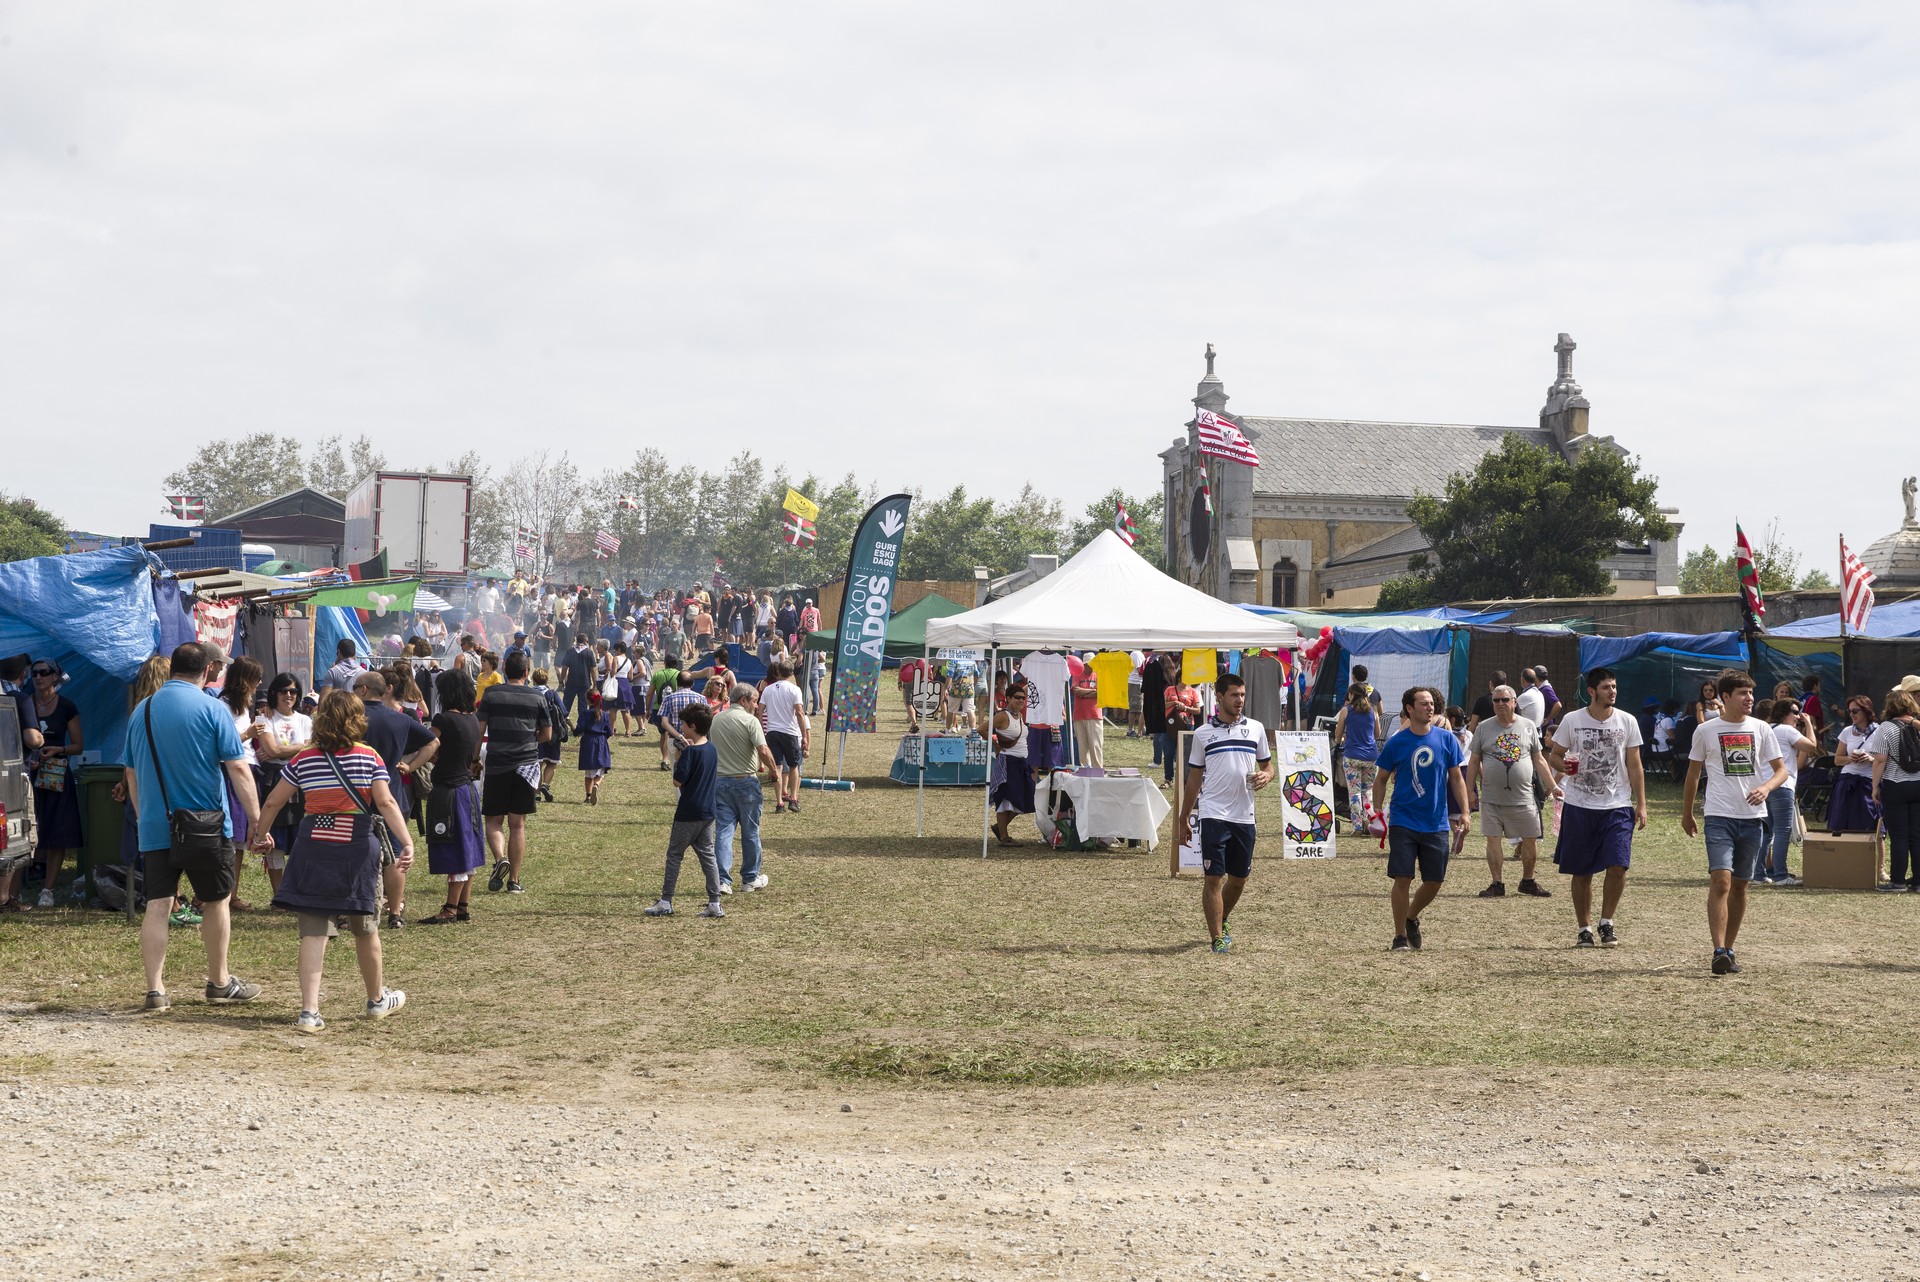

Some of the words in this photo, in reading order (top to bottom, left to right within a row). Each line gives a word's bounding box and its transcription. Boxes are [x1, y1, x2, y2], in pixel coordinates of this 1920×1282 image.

[875, 541, 897, 552] GURE
[874, 549, 896, 560] ESKU
[872, 557, 894, 567] DAGO
[844, 574, 869, 656] GETXON
[860, 575, 890, 660] ADOS
[1295, 846, 1324, 858] SARE
